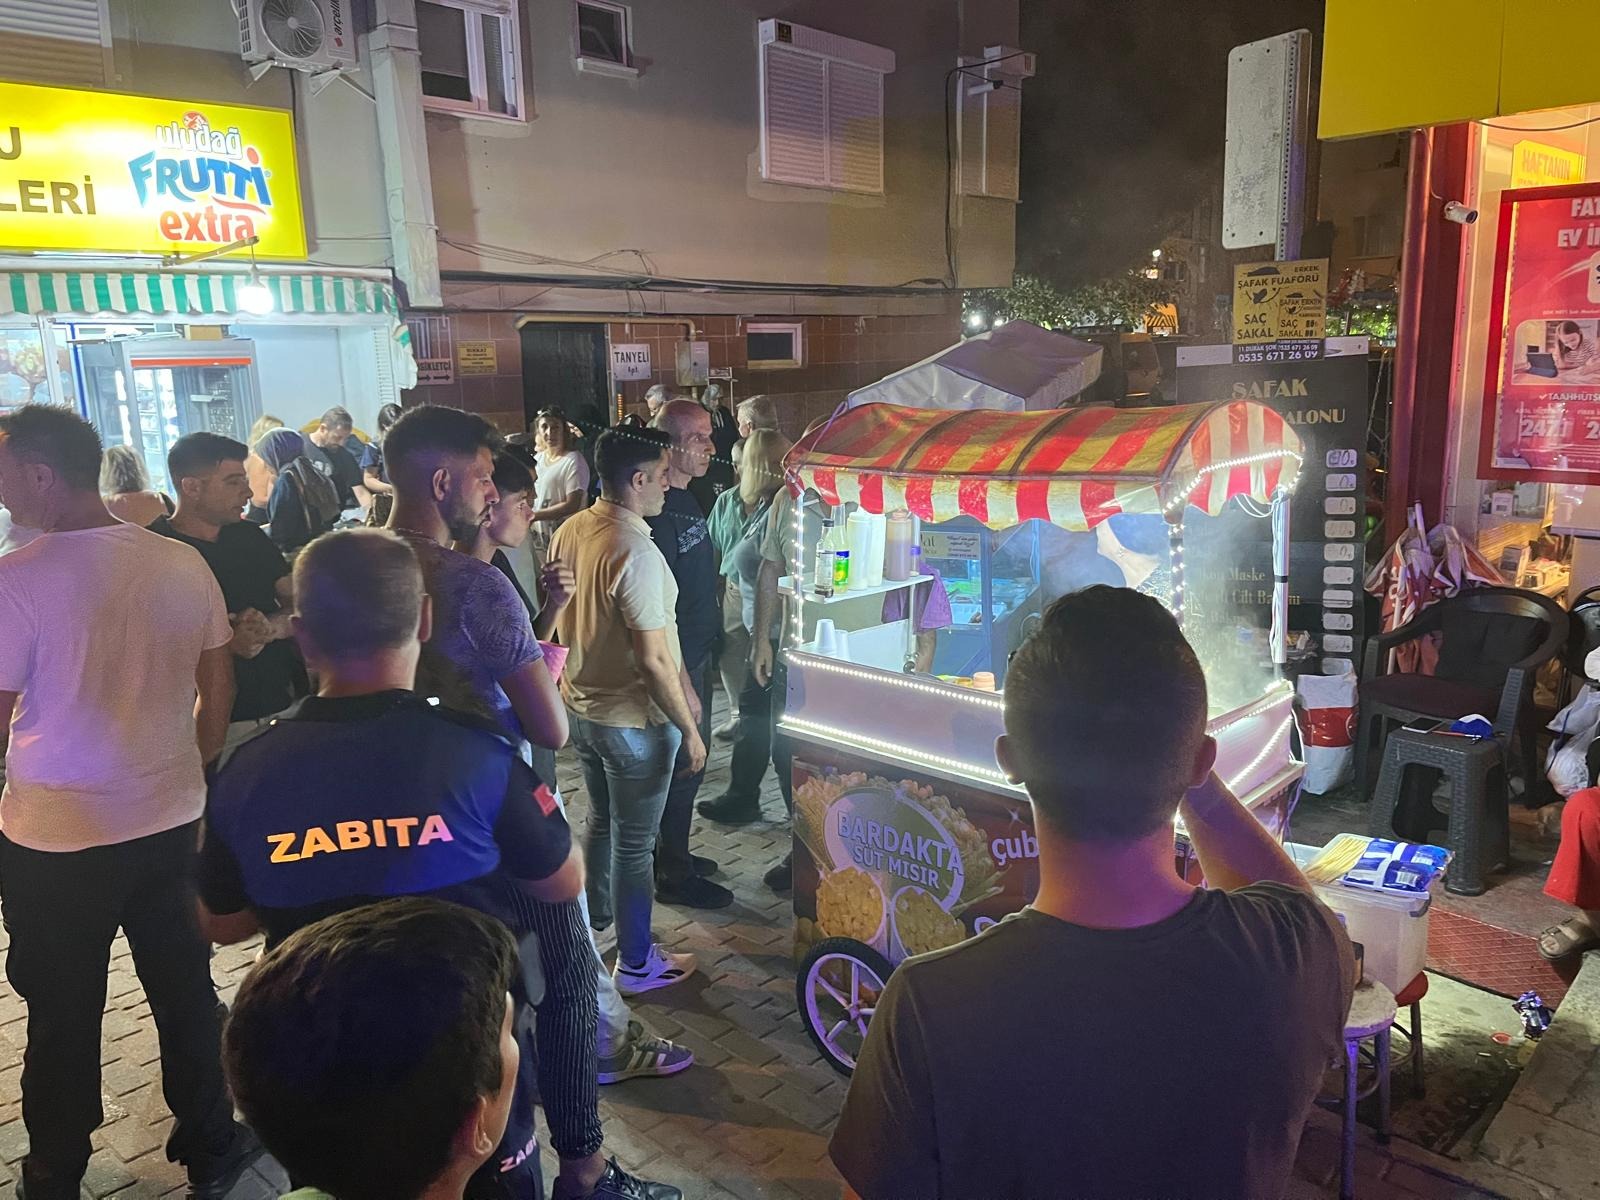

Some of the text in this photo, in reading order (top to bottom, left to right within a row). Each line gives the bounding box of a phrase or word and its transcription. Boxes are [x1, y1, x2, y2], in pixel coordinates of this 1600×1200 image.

[155, 121, 243, 160] uludağ
[159, 205, 255, 243] extra
[1557, 228, 1583, 248] EV
[1237, 278, 1268, 290] ŞAFAK
[1244, 313, 1267, 327] SAÇ
[1280, 319, 1298, 328] SAÇ
[1236, 327, 1274, 340] SAKAL
[614, 347, 649, 364] TANYELİ
[1238, 352, 1263, 363] 0535
[1265, 351, 1284, 361] 671
[1288, 350, 1302, 360] 26
[1279, 407, 1346, 425] ALONU
[1584, 420, 1600, 439] 2
[1229, 567, 1266, 581] Maske
[1232, 588, 1252, 605] Cilt
[266, 814, 455, 864] ZABITA
[837, 811, 964, 876] BARDAKTA
[854, 842, 941, 890] SÜT MISIR
